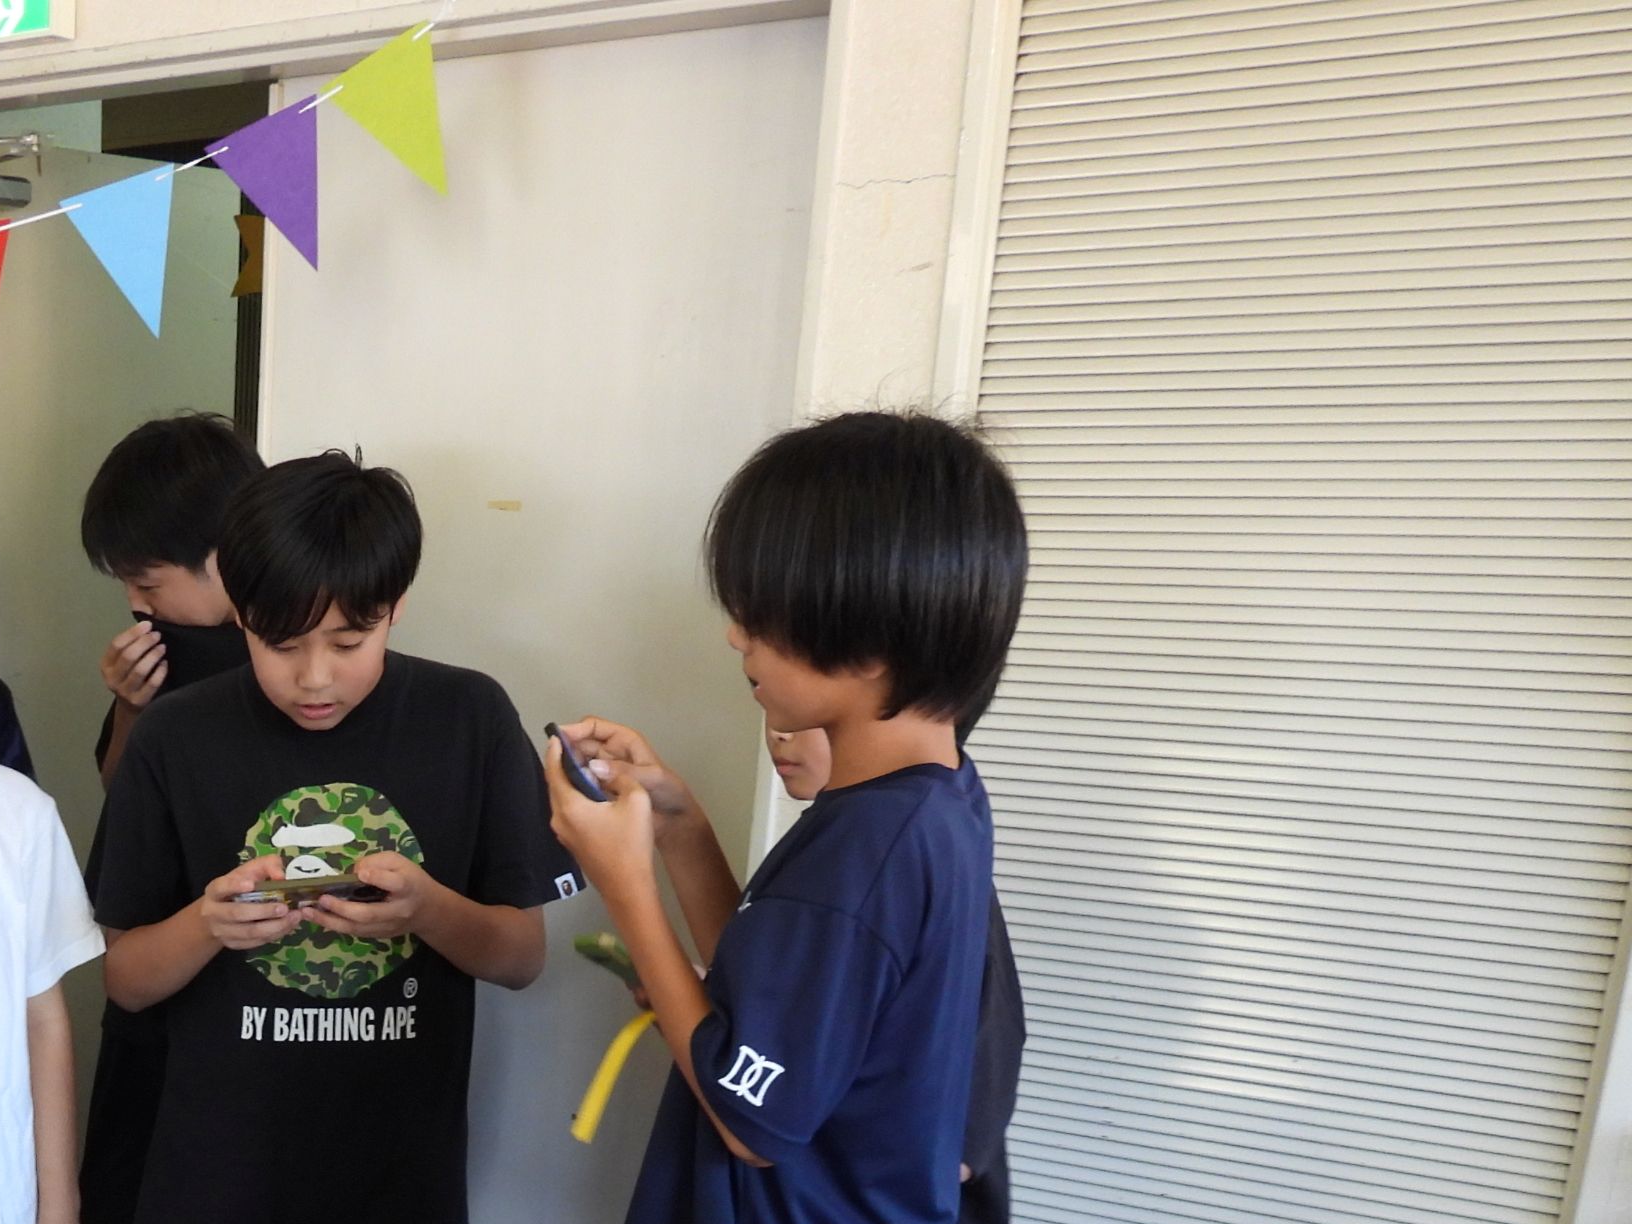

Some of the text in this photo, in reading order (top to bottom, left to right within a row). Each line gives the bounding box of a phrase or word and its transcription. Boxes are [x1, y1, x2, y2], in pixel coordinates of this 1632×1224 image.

[240, 1005, 417, 1042] BY BATHING APE
